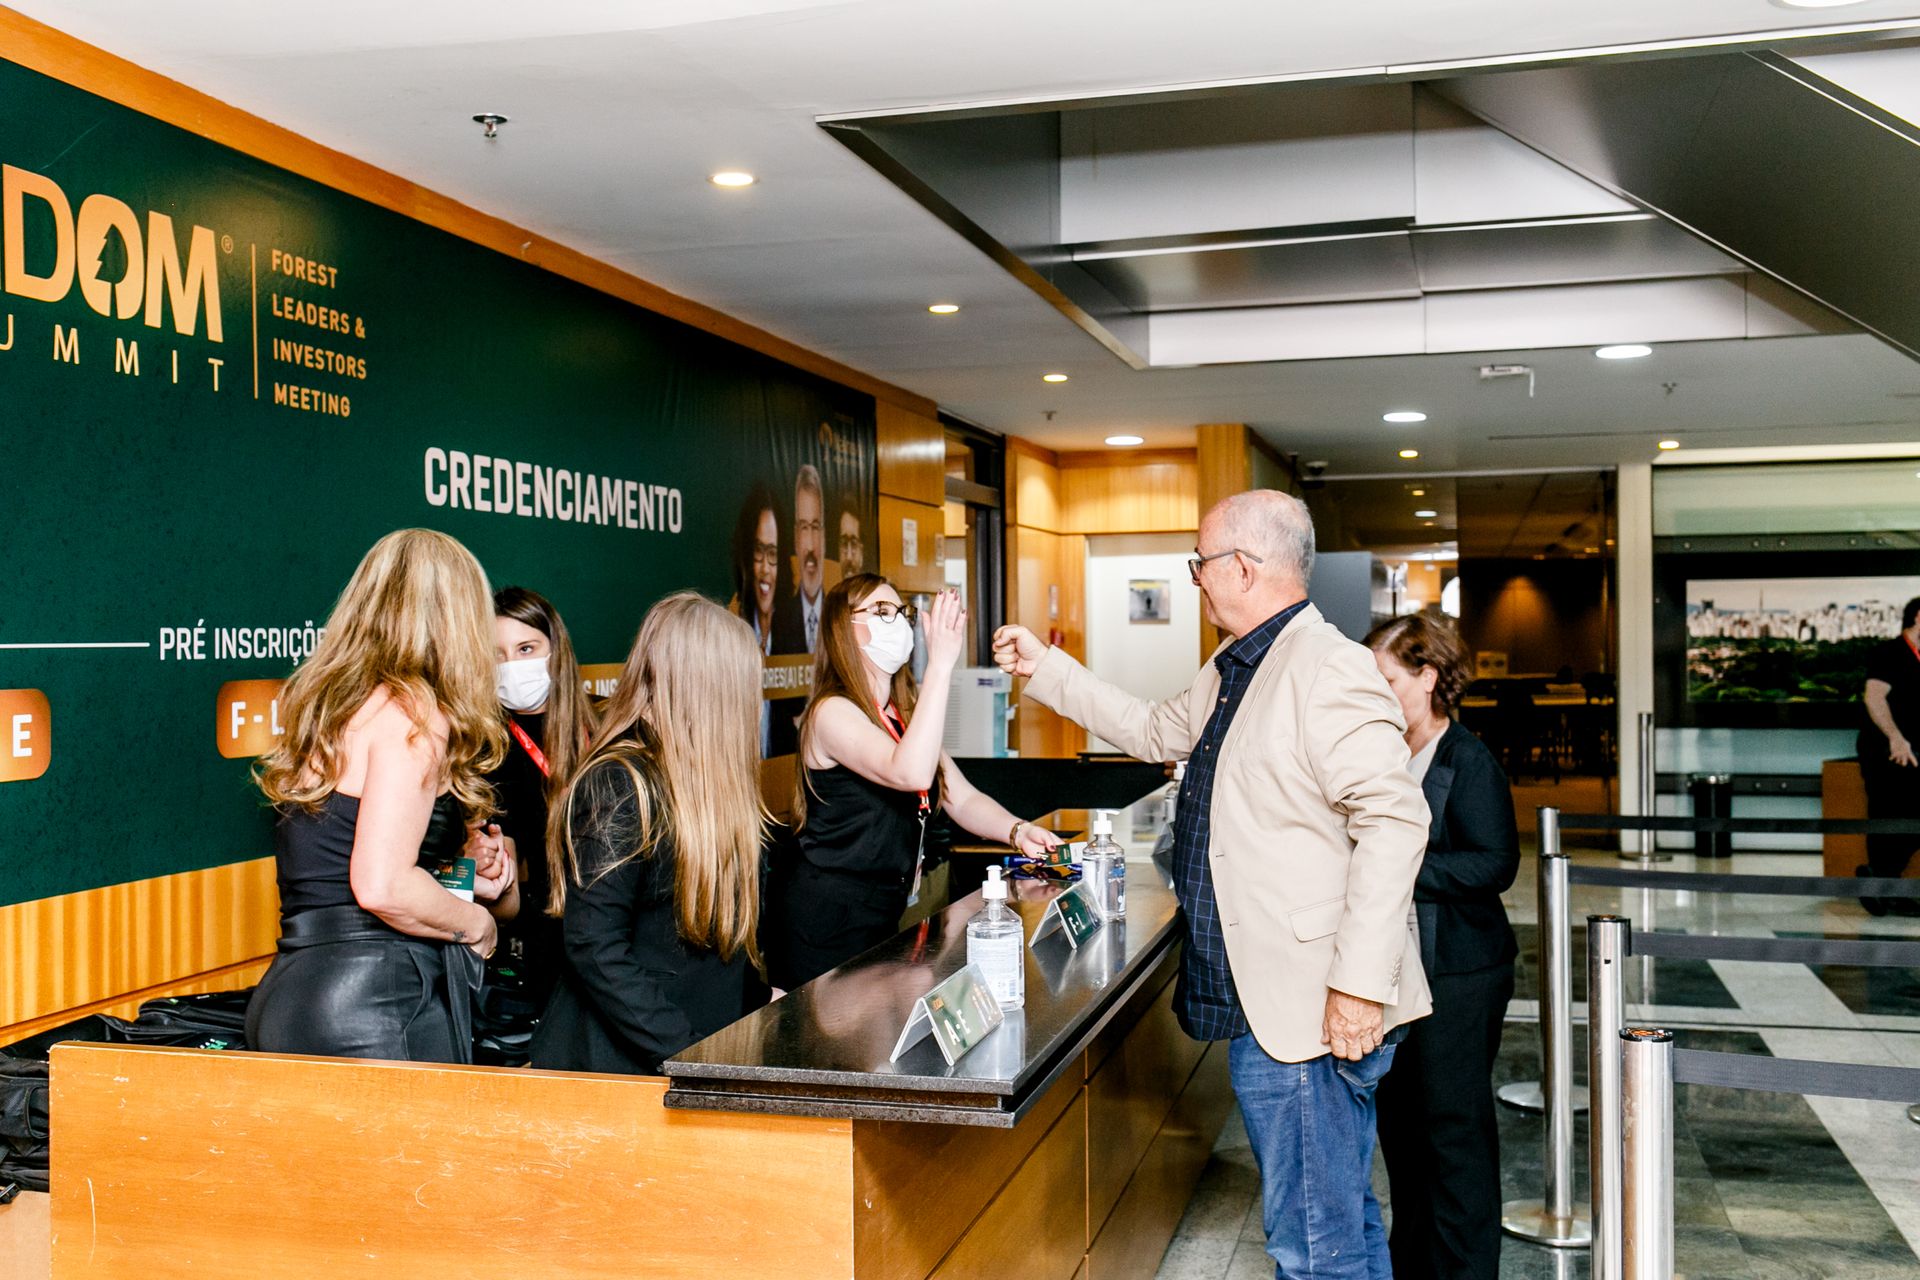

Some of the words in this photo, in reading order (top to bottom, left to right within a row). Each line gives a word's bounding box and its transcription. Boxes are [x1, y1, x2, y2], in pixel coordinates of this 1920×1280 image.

[271, 249, 338, 289] FOREST
[272, 293, 350, 335] LEADERS
[354, 317, 366, 340] &
[273, 338, 367, 380] INVESTORS
[274, 382, 351, 418] MEETING
[424, 446, 682, 534] CREDENCIAMENTO
[159, 619, 206, 661] PRÉ
[12, 713, 33, 758] E
